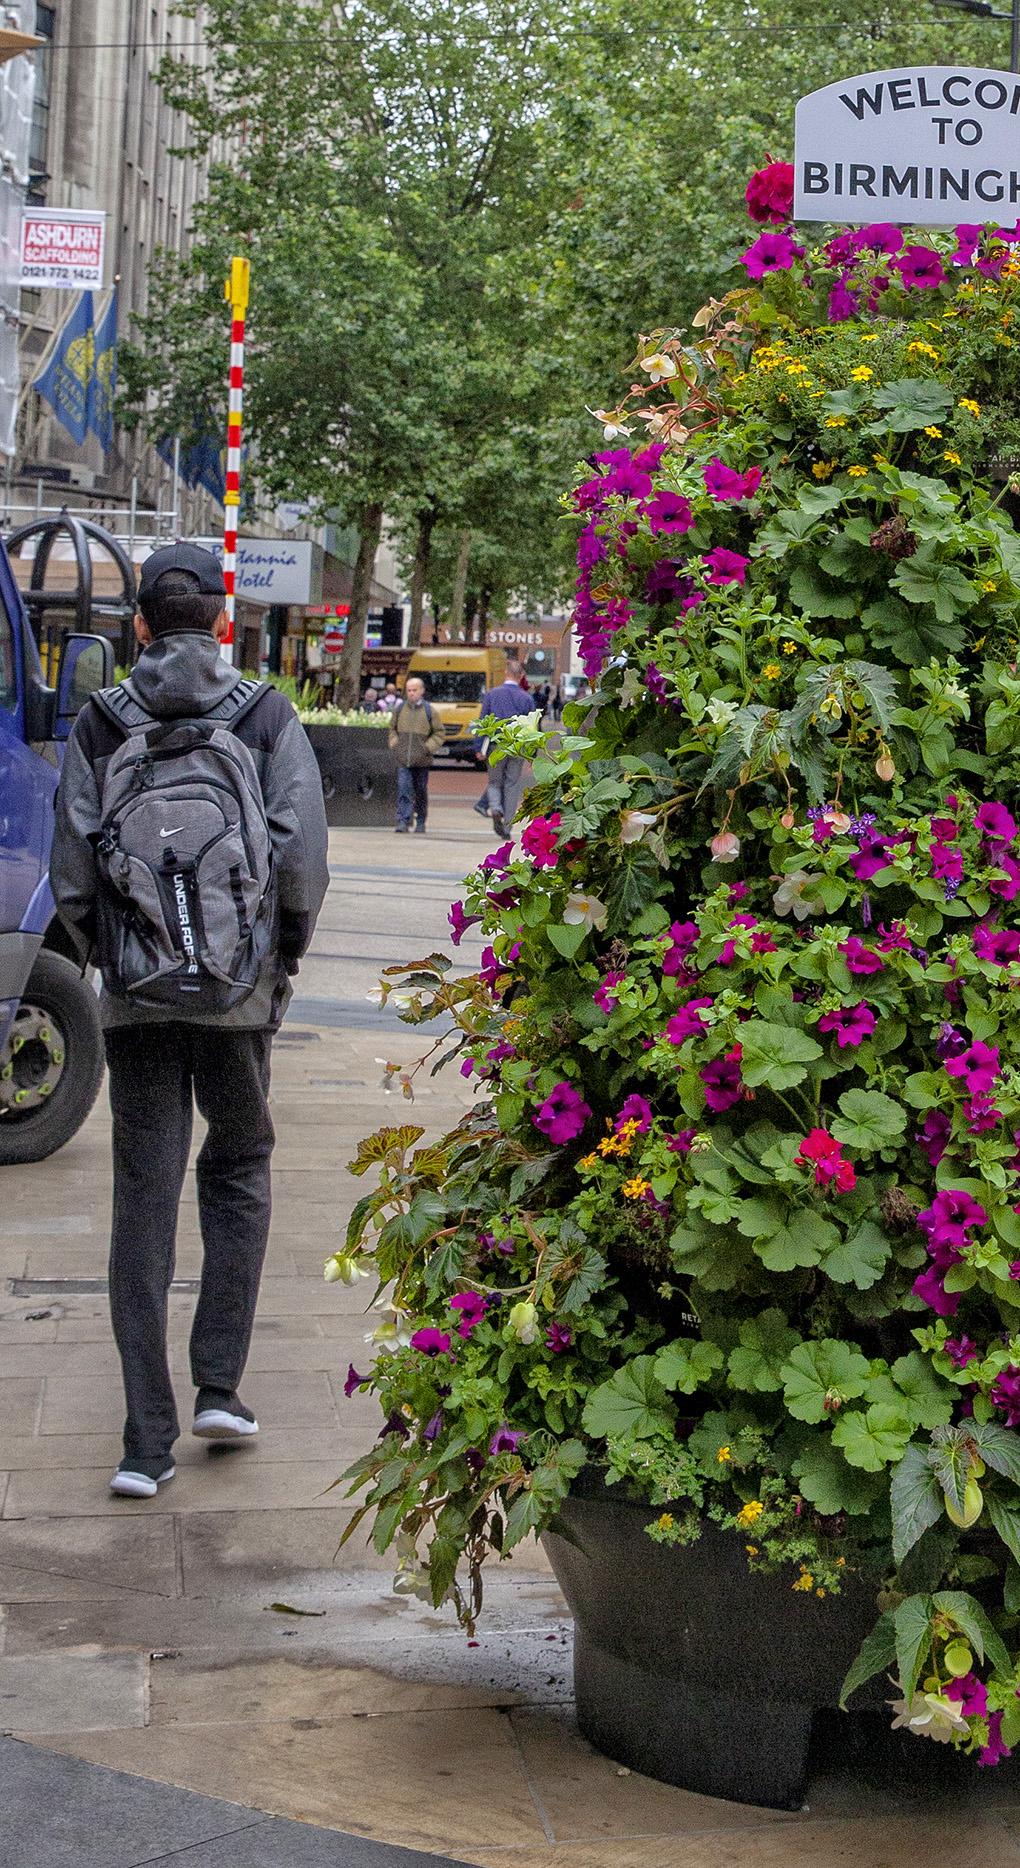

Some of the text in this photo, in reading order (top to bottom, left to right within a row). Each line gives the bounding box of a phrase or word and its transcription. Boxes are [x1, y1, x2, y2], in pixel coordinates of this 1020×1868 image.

[932, 118, 983, 146] TO
[24, 247, 98, 264] SCAFFOLDING
[22, 266, 98, 280] 0121 772 1422
[211, 545, 297, 565] Btannia
[445, 630, 543, 645] AESTONES
[173, 874, 190, 925] UNDER
